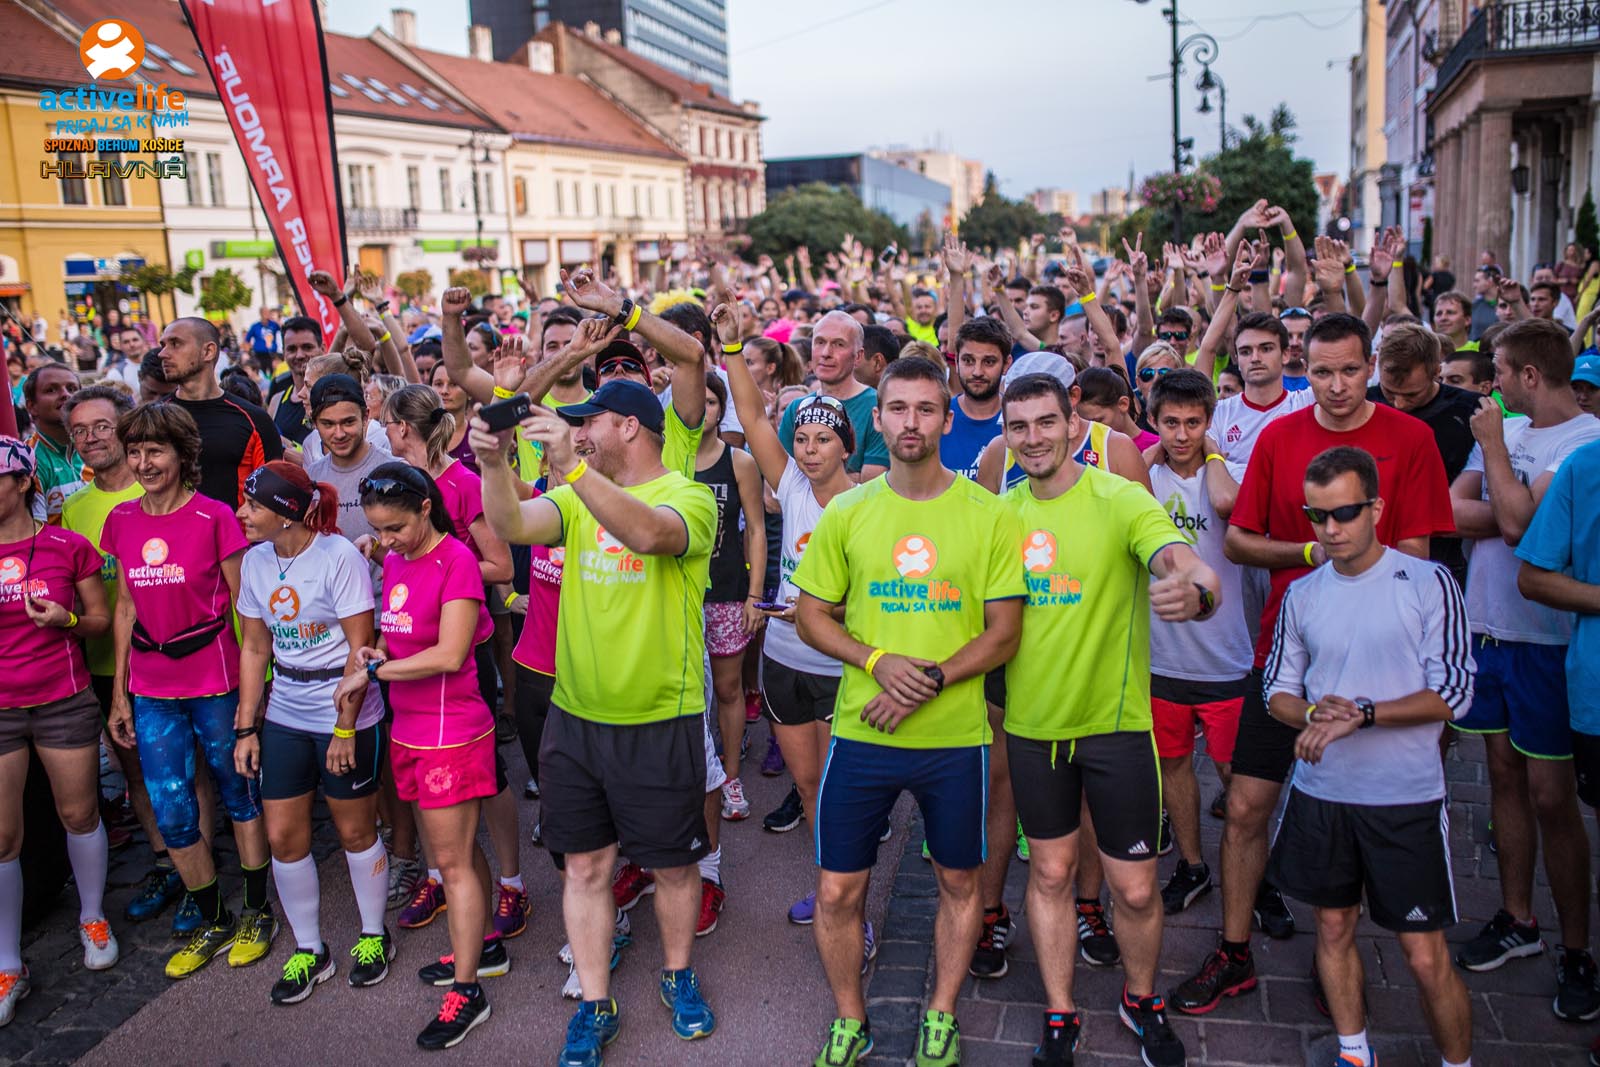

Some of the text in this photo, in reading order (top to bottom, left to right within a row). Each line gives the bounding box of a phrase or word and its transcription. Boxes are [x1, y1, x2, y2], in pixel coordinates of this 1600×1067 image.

[1169, 512, 1208, 531] bok
[128, 563, 185, 579] activelife
[868, 578, 962, 601] activelife
